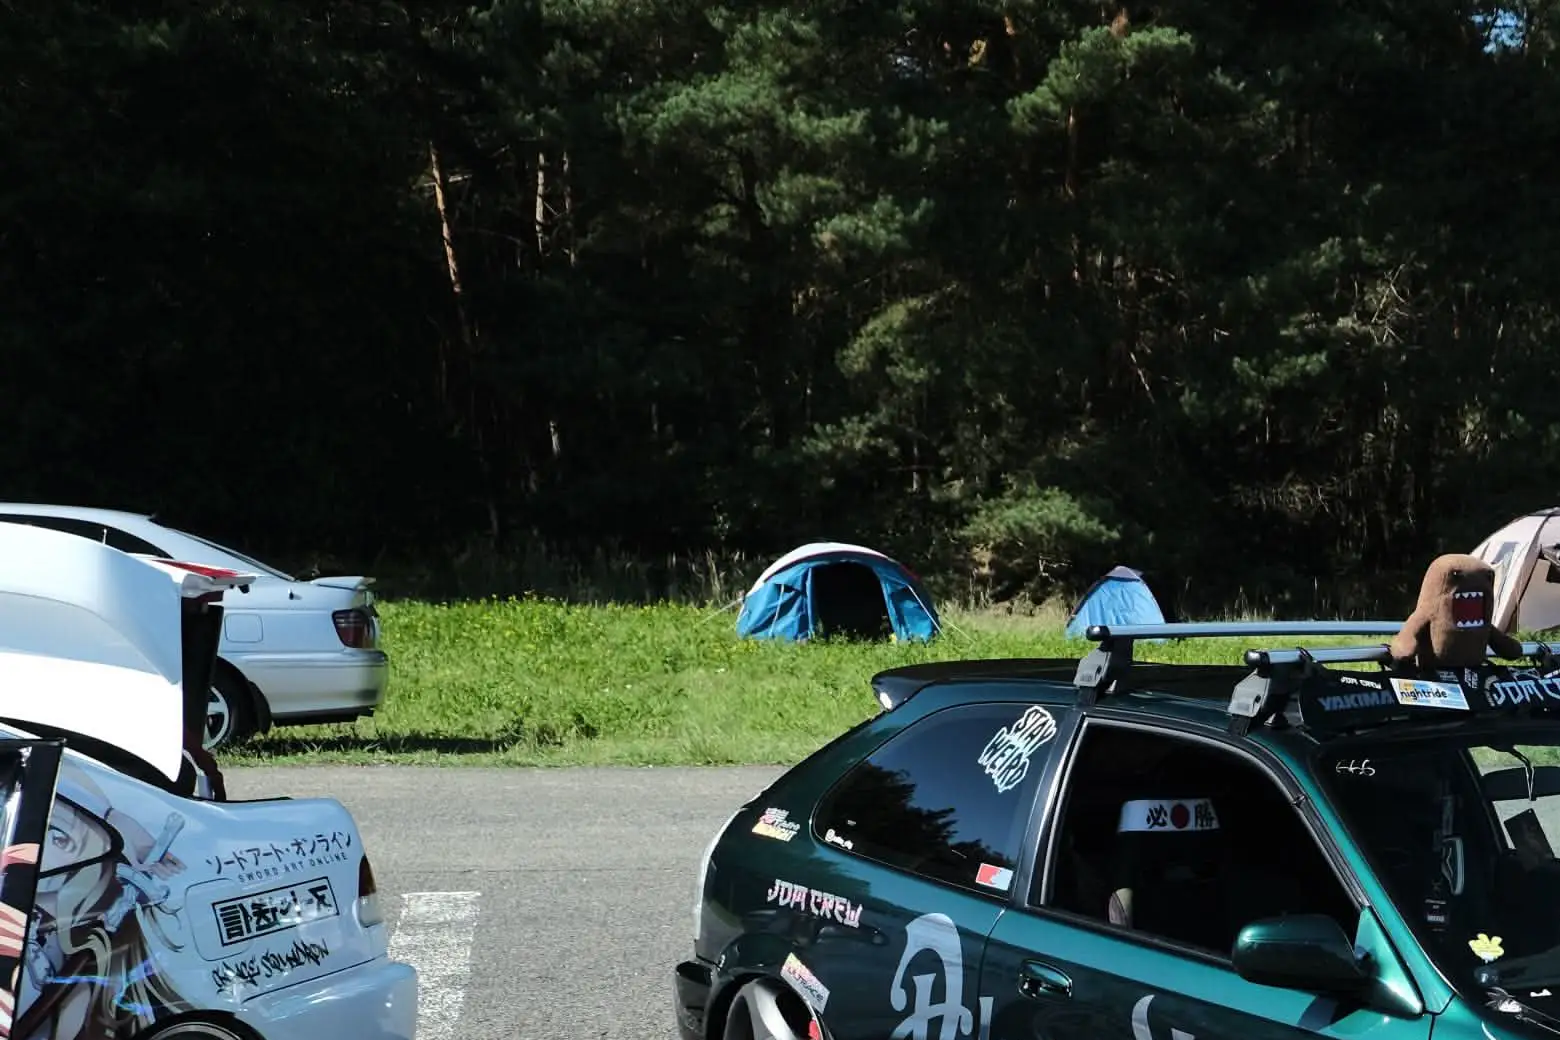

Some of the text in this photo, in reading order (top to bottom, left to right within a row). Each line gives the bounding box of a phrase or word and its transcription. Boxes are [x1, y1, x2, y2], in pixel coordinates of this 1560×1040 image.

[1318, 690, 1395, 711] YAKIMA
[1400, 688, 1448, 701] nightride
[1493, 680, 1543, 705] JDM
[1011, 705, 1057, 758] STAY
[978, 726, 1030, 793] WEIRD
[238, 851, 348, 882] SWORD ART ONLINE
[767, 878, 863, 928] JDM CREW
